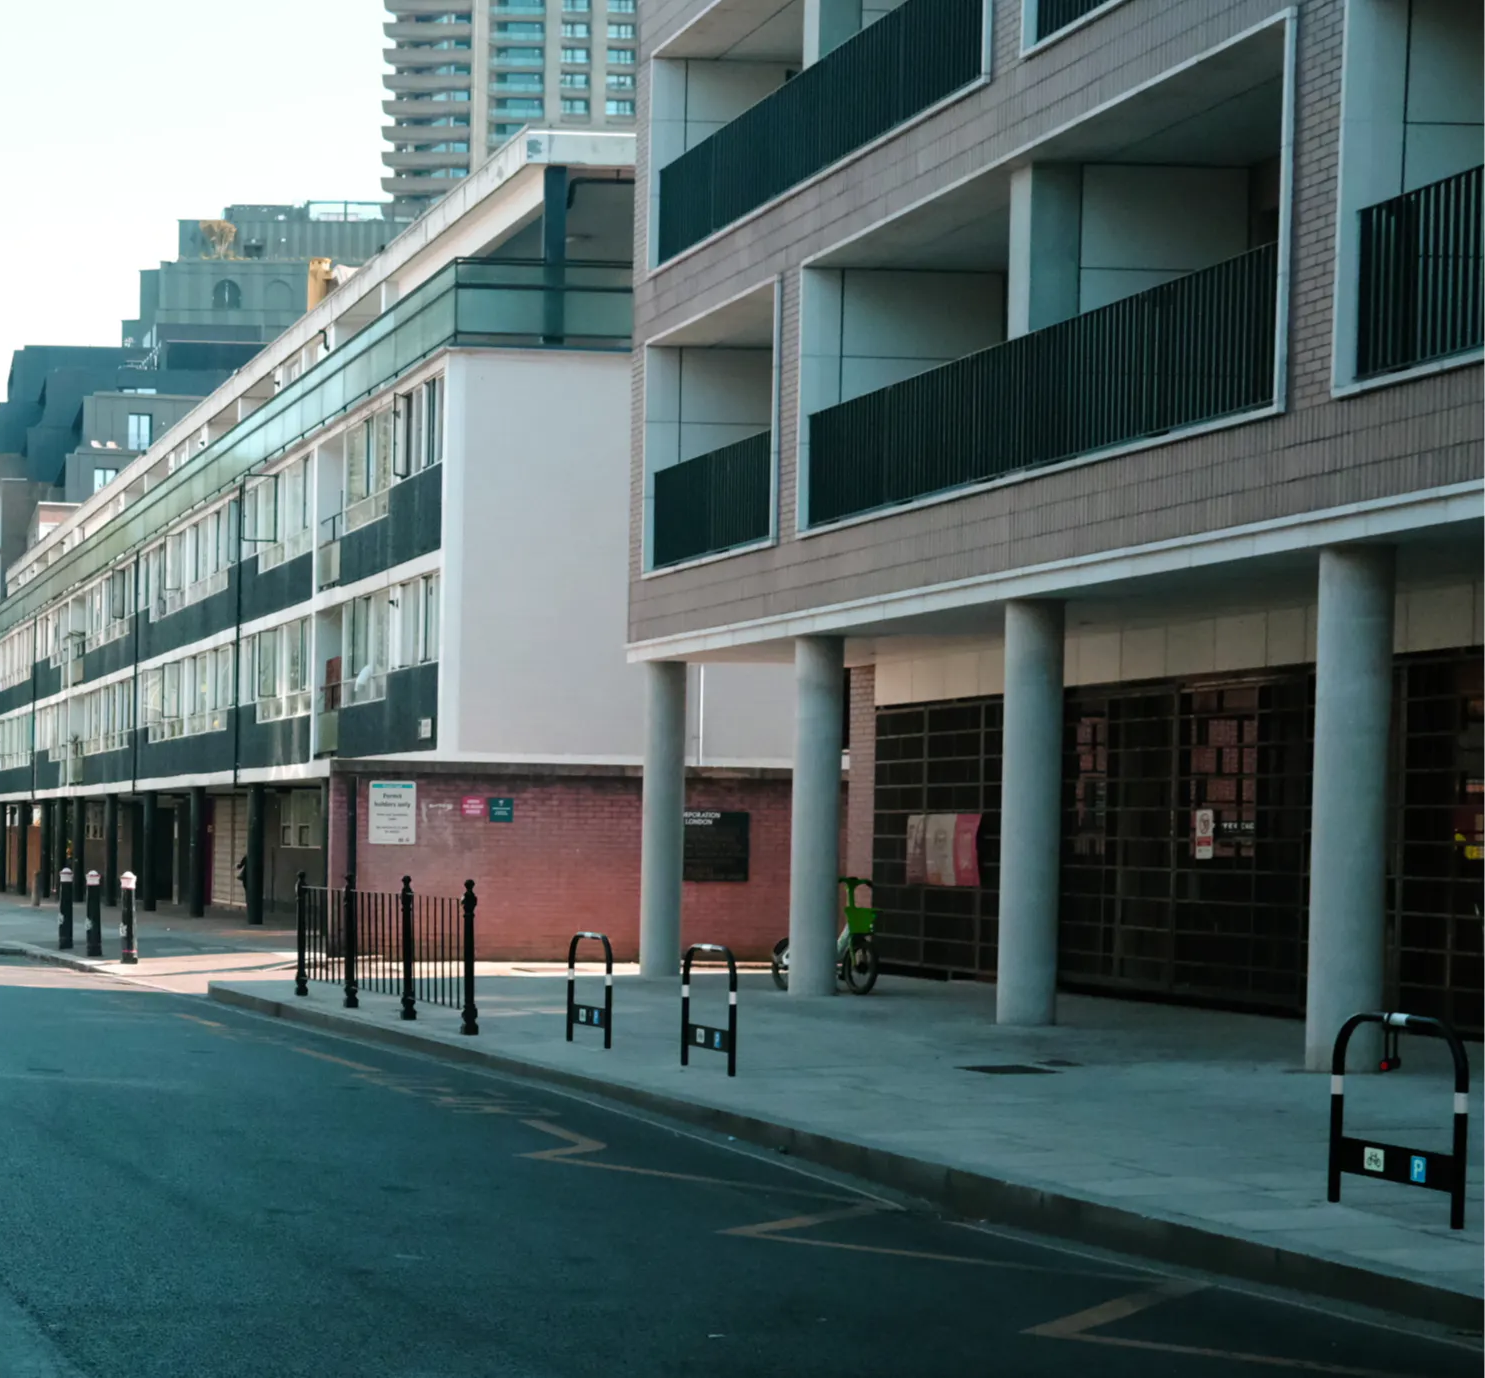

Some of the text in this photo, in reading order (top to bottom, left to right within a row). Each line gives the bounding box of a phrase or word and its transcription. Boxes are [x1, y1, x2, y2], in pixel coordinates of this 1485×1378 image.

[397, 801, 411, 809] only
[683, 811, 721, 819] RPORATION
[1414, 1159, 1424, 1178] P
